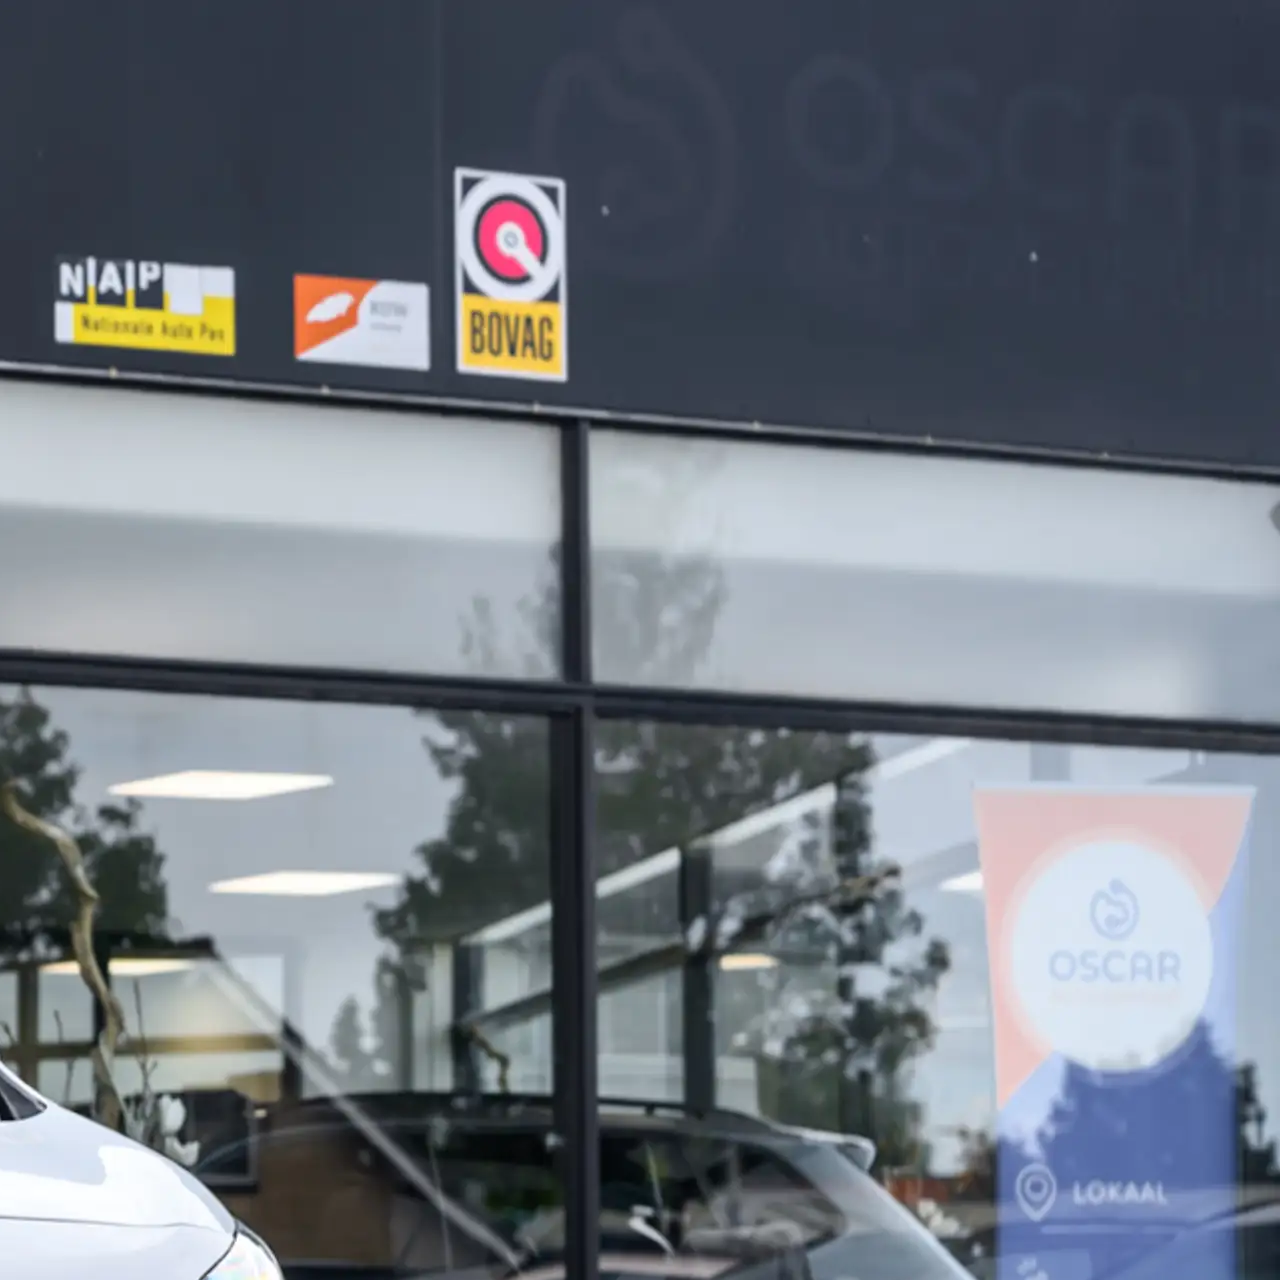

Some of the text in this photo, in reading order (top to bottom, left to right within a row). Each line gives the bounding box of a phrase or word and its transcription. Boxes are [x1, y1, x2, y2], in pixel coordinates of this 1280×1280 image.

[469, 309, 555, 362] BOVAG
[1048, 948, 1183, 983] OSCAR
[1071, 1180, 1169, 1207] LOKAAL
